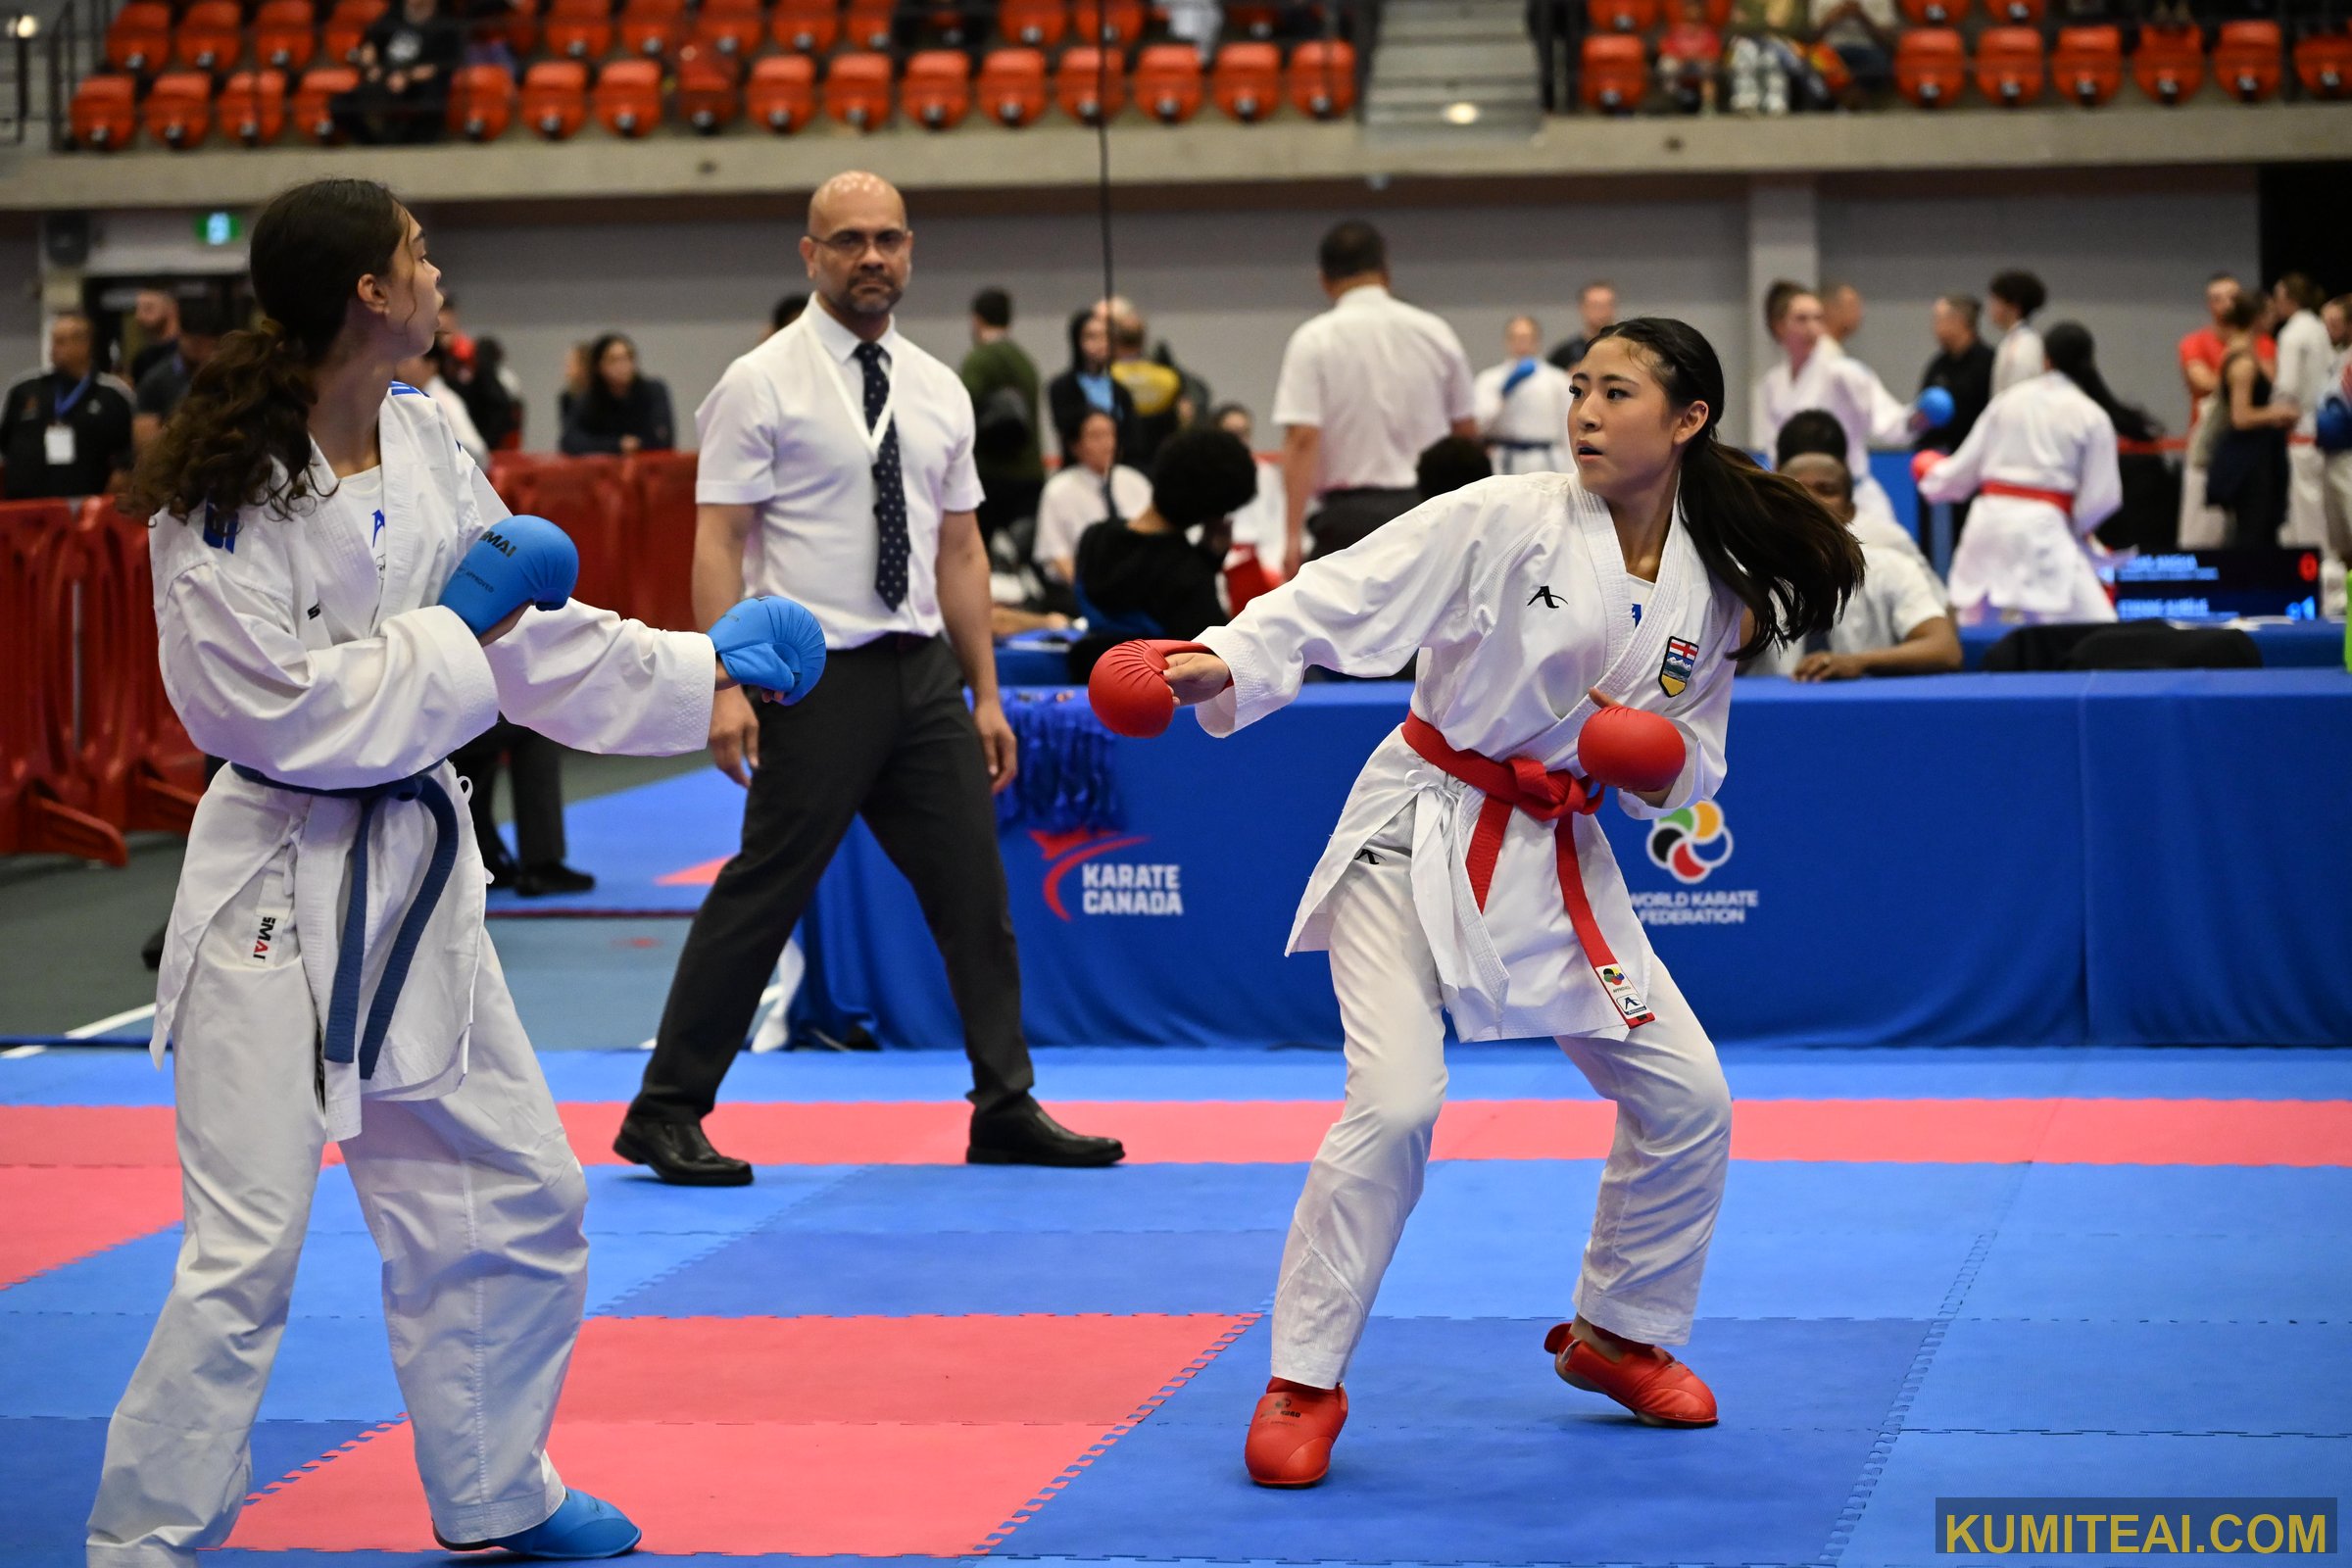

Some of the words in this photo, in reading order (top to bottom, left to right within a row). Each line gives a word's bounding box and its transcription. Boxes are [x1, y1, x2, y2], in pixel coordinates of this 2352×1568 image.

[1082, 863, 1181, 889] KARATE
[1082, 890, 1184, 915] CANADA
[1629, 891, 1690, 907] WORLD
[1690, 890, 1759, 907] KARATE
[1638, 908, 1745, 925] FEDERATION
